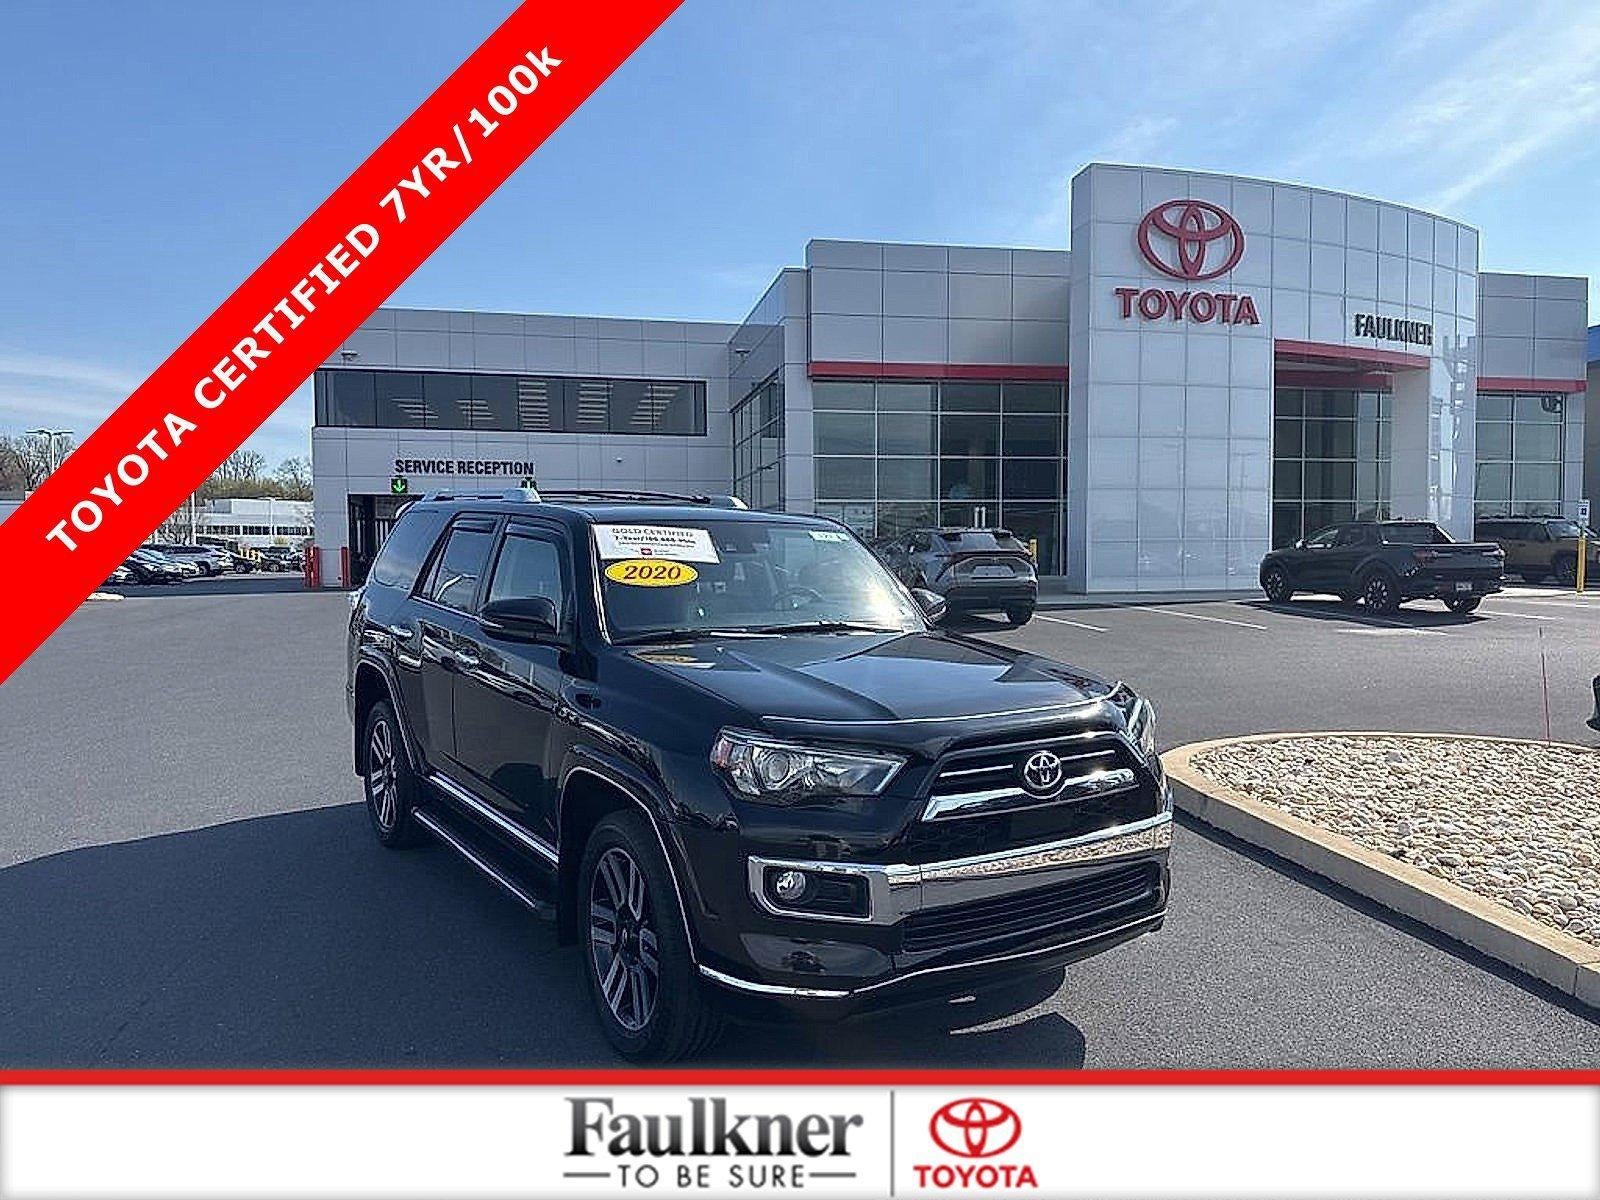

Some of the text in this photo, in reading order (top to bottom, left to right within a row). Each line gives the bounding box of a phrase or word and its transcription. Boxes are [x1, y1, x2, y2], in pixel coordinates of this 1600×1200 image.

[1114, 287, 1260, 326] TOYOTA
[1354, 313, 1433, 346] FAULKNER
[394, 458, 534, 476] SERVICE RECEPTION
[623, 565, 682, 580] 2020
